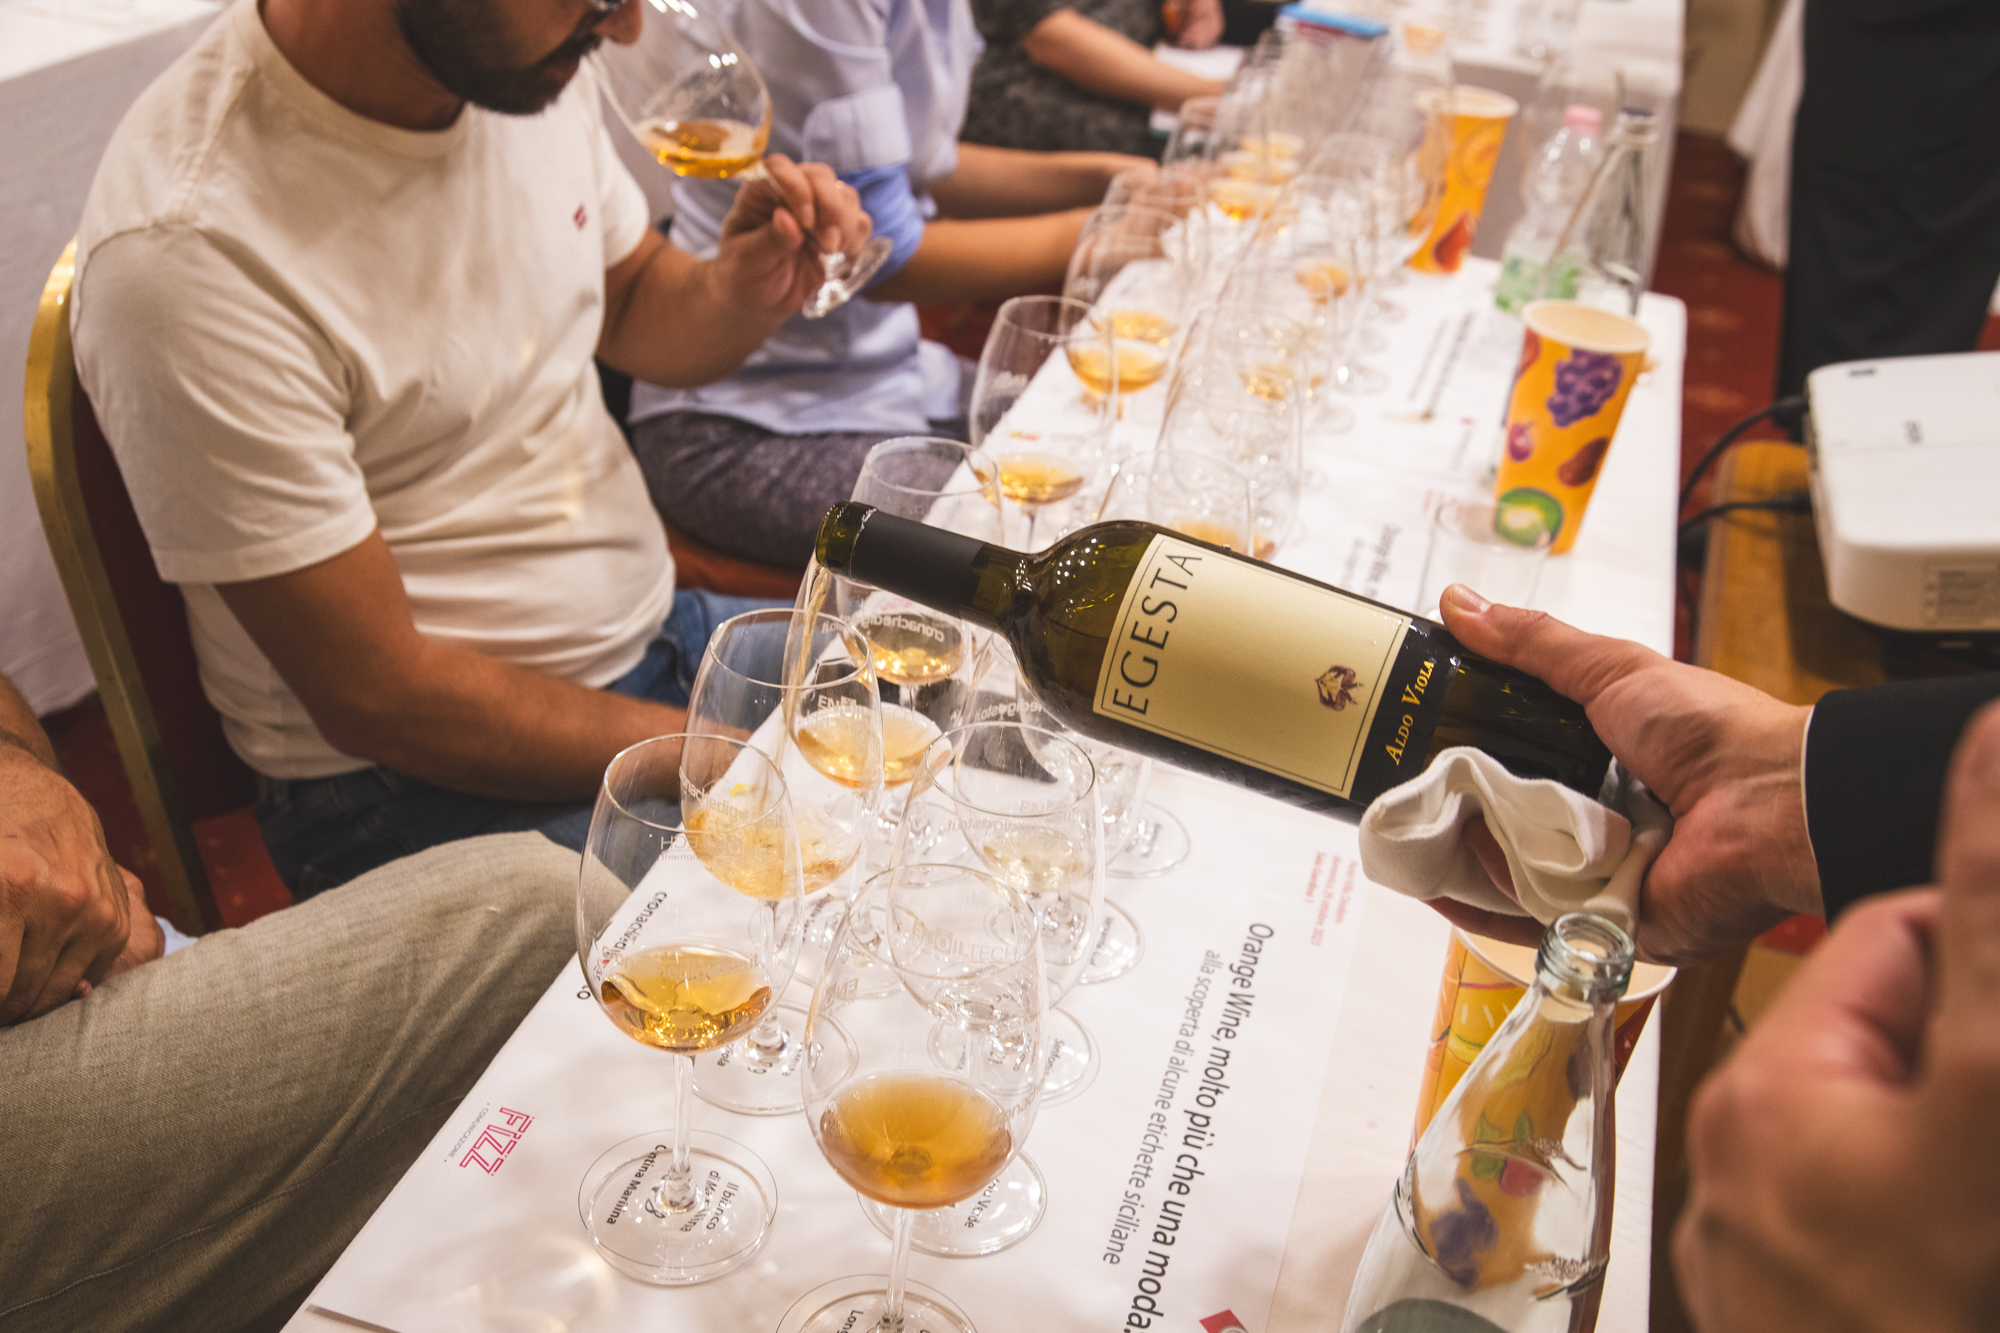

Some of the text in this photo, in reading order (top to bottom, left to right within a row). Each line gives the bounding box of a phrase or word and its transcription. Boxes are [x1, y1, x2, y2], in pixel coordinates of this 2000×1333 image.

[1112, 554, 1202, 715] EGESTA
[1385, 660, 1435, 766] ALDO VIOLA
[1229, 923, 1274, 989] Orange
[1211, 992, 1256, 1041] Wine,
[1102, 950, 1223, 1265] alla scoperta di alcune etichette siciliane
[1196, 1046, 1231, 1108] molto
[459, 1107, 535, 1176] FIZZ
[1183, 1109, 1215, 1150] più
[1168, 1153, 1205, 1196] che
[1152, 1199, 1186, 1247] una
